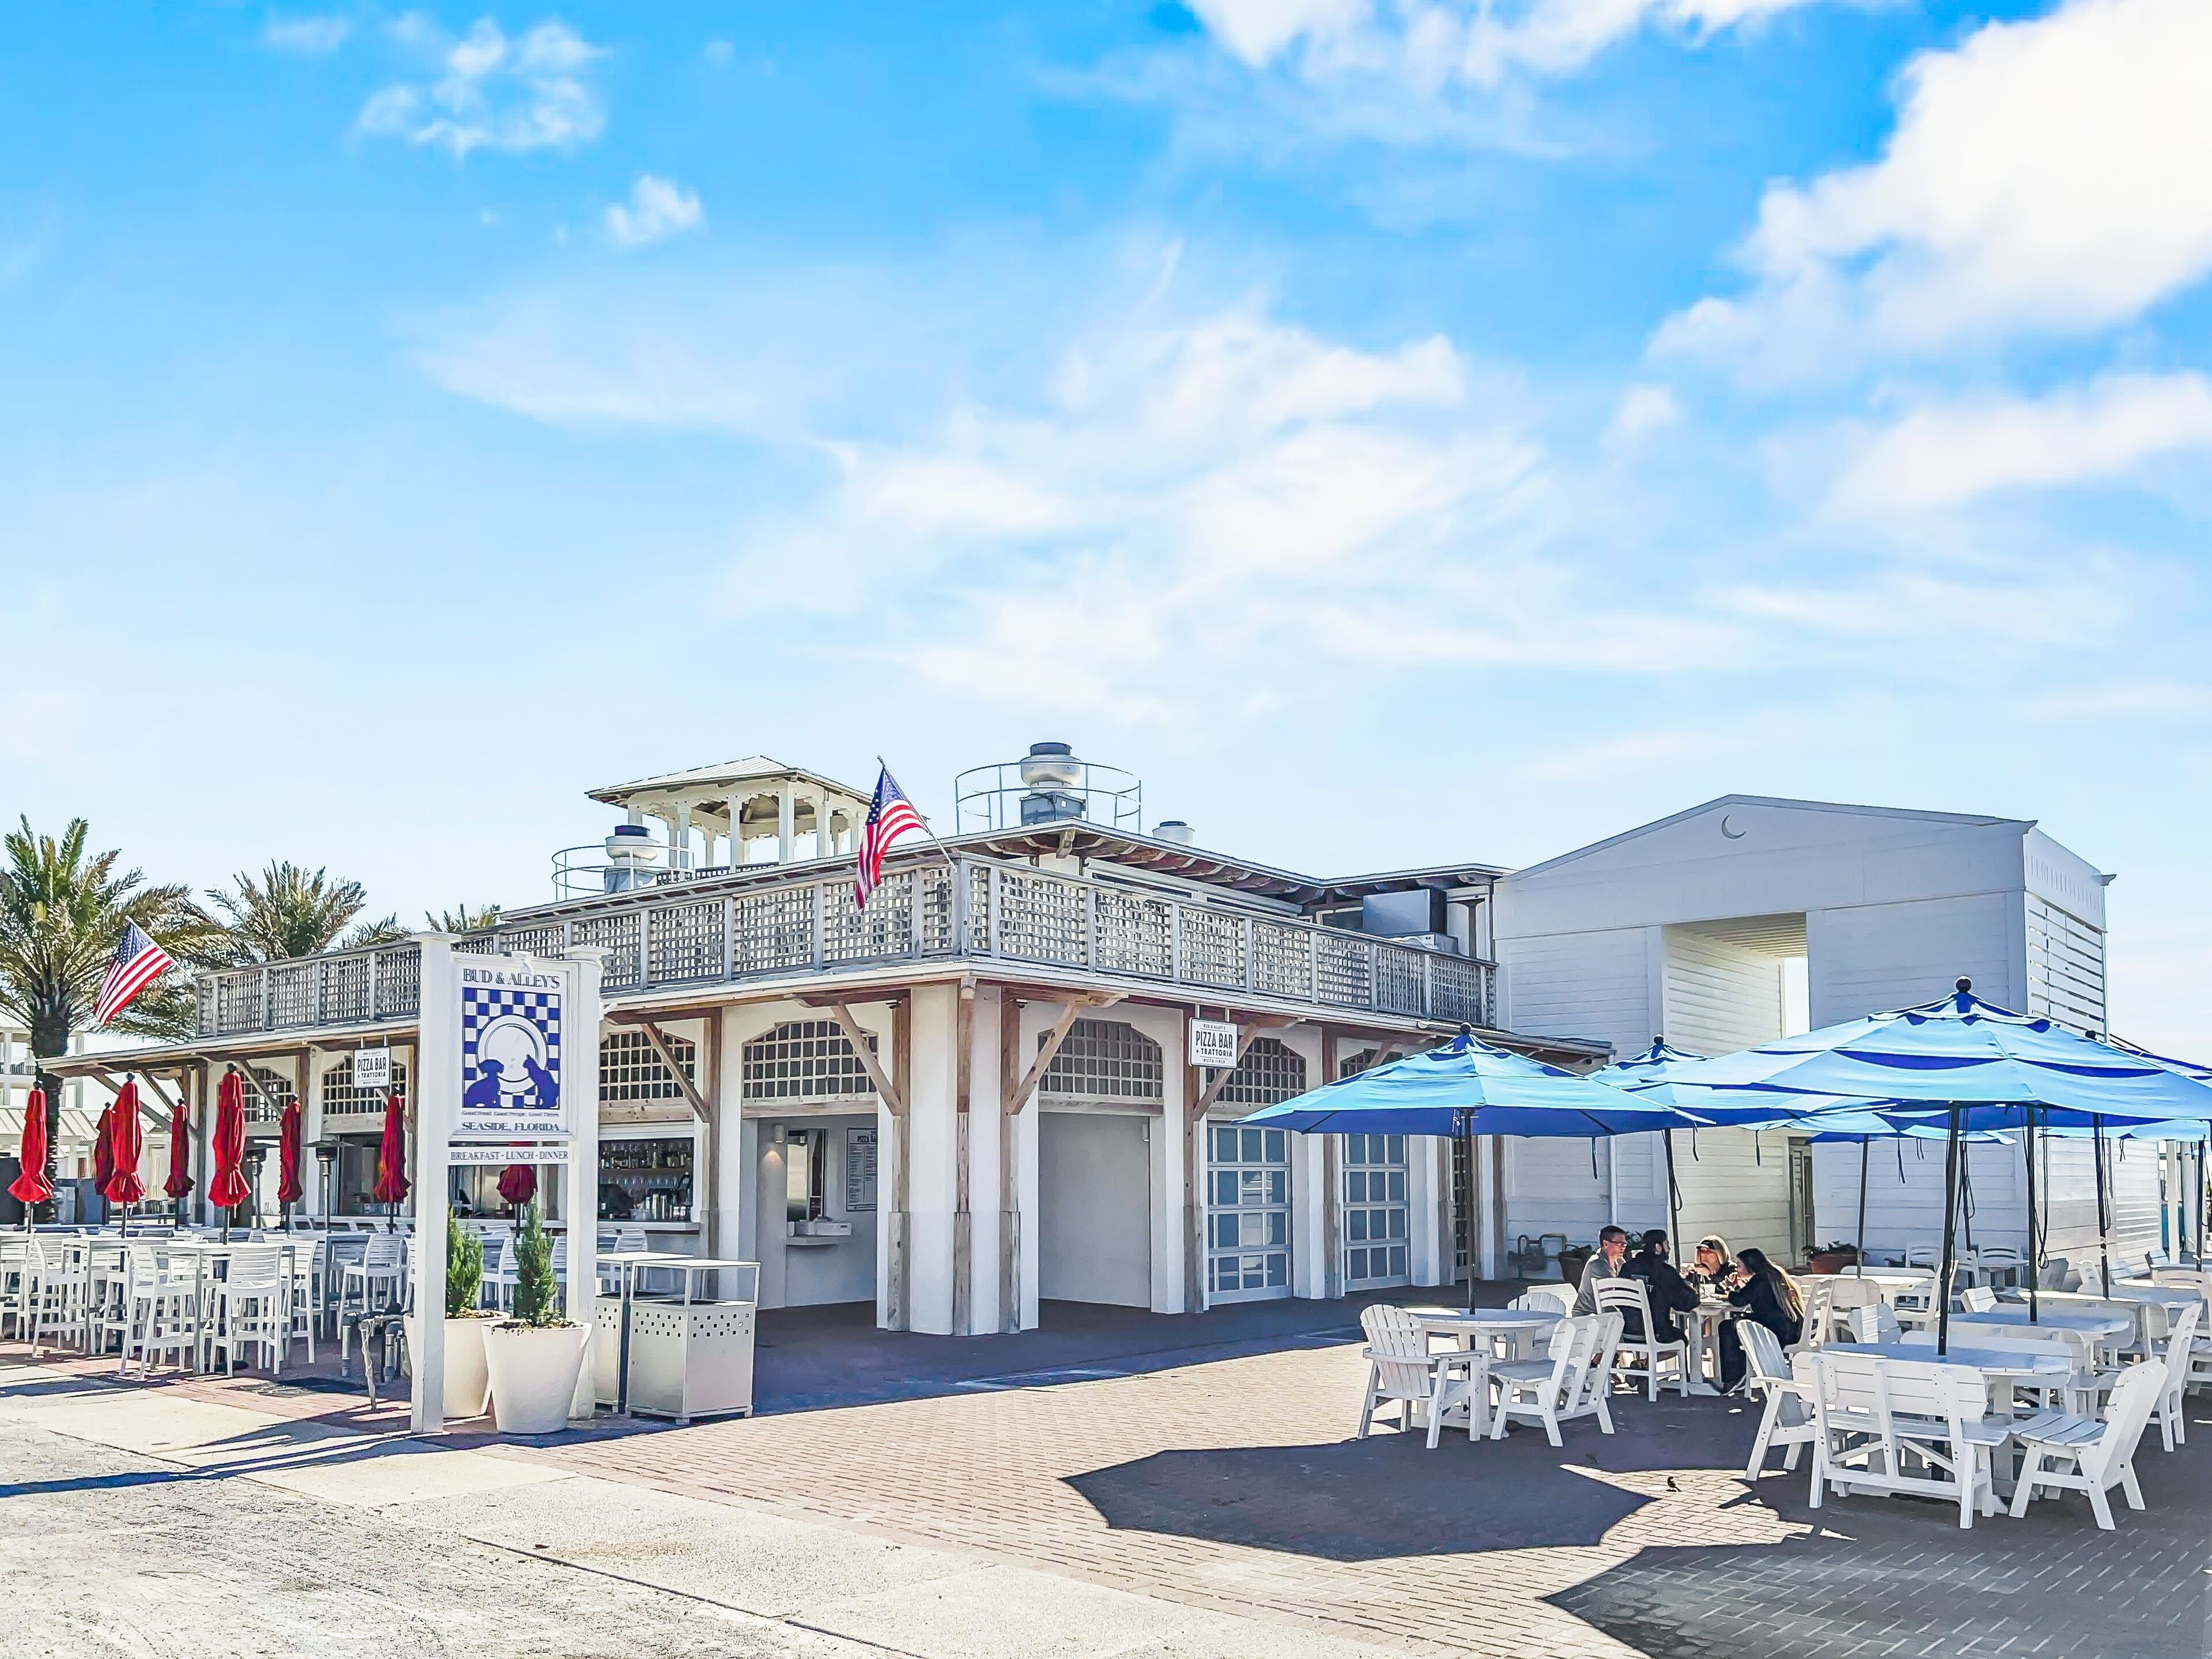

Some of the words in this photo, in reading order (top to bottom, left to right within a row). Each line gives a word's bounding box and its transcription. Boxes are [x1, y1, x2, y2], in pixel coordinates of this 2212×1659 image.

[463, 968, 493, 983] BUD
[495, 972, 505, 984] &
[507, 972, 560, 989] ALLEY'S
[1196, 1031, 1216, 1047] PIZZA
[1219, 1033, 1232, 1049] BAR
[1201, 1048, 1232, 1056] TRATTORIA
[358, 1058, 373, 1071] PIZZA
[375, 1057, 386, 1070] BAR
[514, 1123, 559, 1131] FLORIDA
[450, 1152, 500, 1160] BREAKFAST
[506, 1152, 533, 1160] LUNCH
[539, 1151, 569, 1160] DINNER
